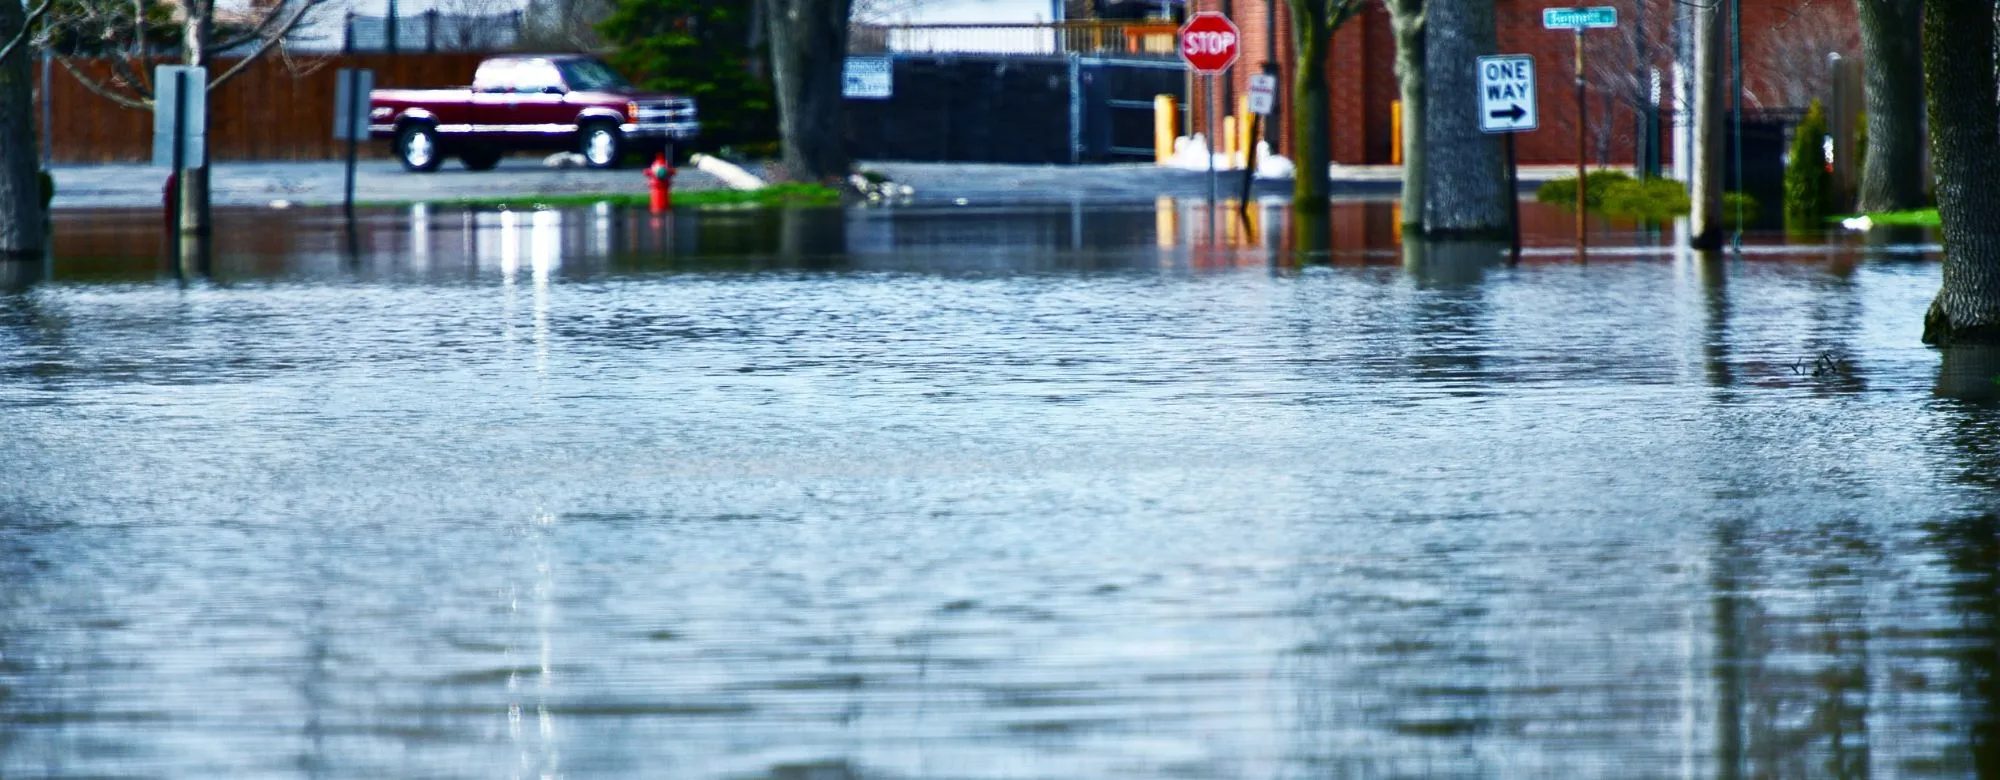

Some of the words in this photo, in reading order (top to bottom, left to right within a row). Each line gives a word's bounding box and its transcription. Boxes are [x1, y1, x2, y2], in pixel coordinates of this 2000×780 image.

[1185, 31, 1235, 55] STOP
[1486, 62, 1526, 81] ONE
[1487, 82, 1527, 100] WAY
